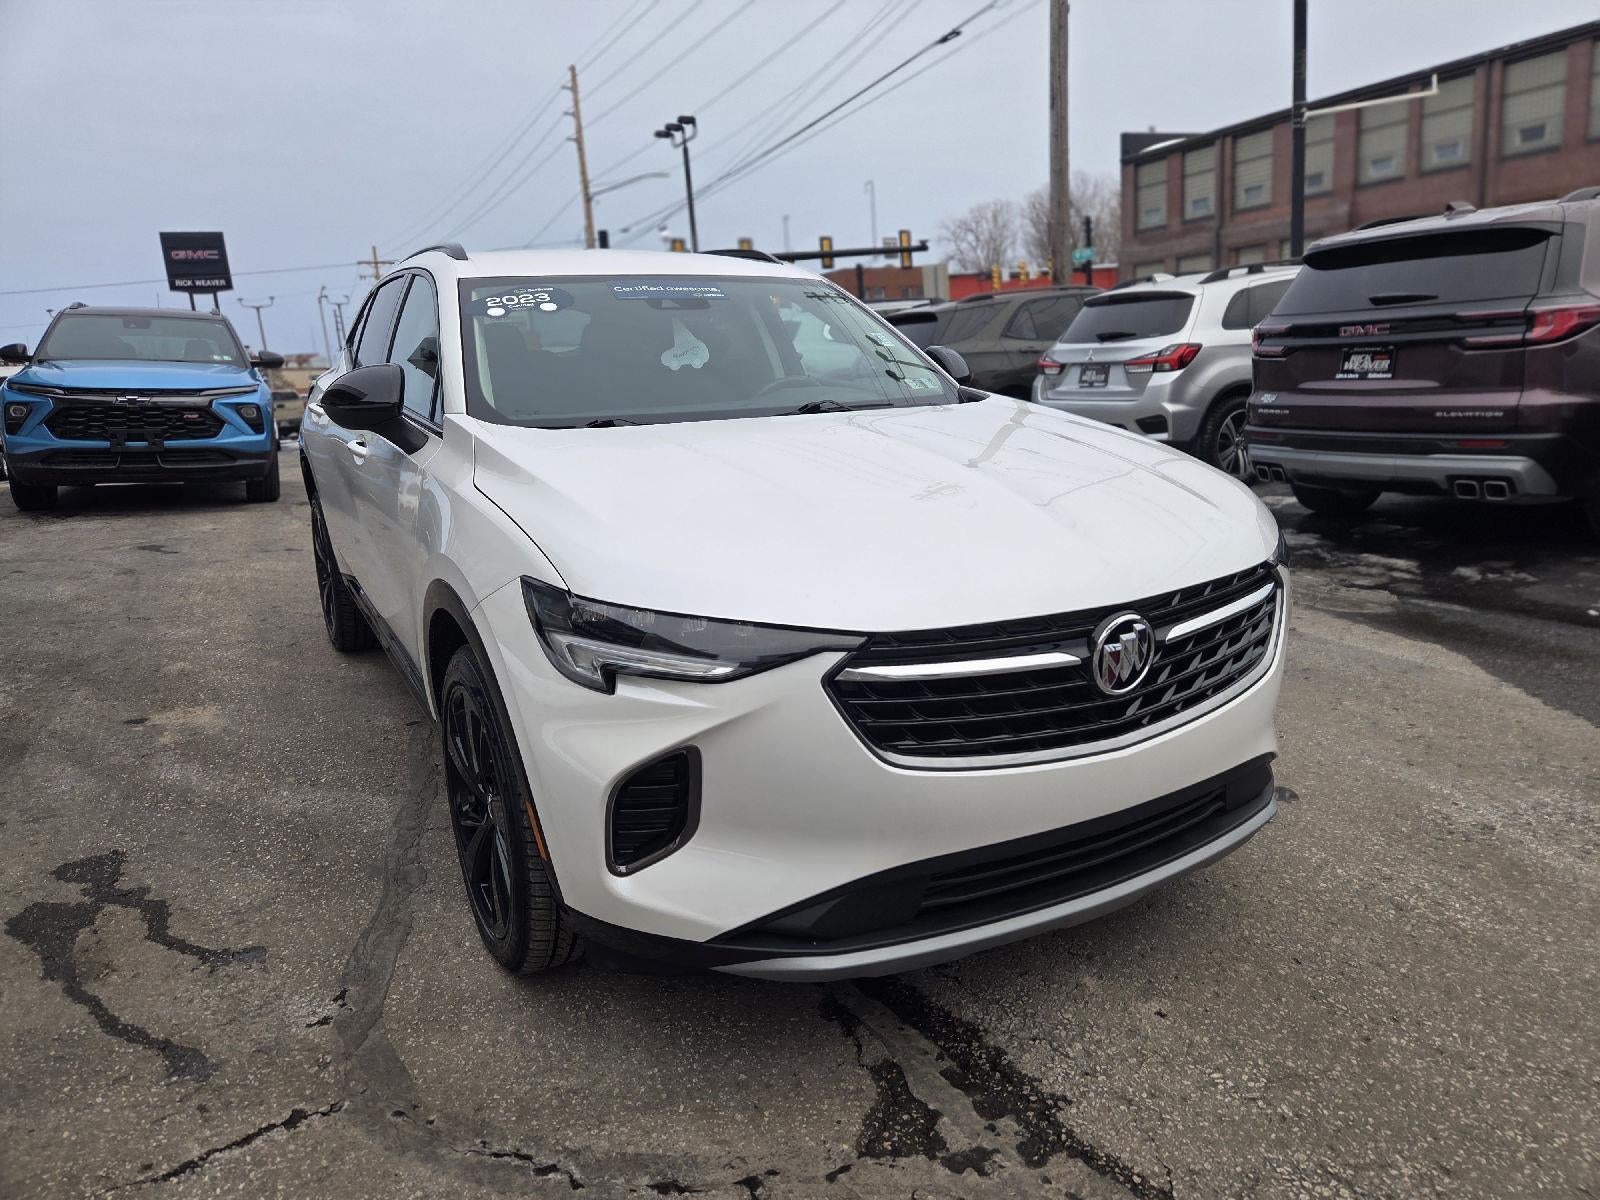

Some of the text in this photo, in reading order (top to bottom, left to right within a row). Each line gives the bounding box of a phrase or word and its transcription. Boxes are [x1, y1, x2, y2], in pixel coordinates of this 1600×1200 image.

[171, 249, 219, 260] GMC
[175, 279, 226, 287] RICK WEAVER
[485, 293, 551, 307] 2023
[1339, 324, 1391, 337] GMC
[1343, 360, 1391, 372] WEAVER
